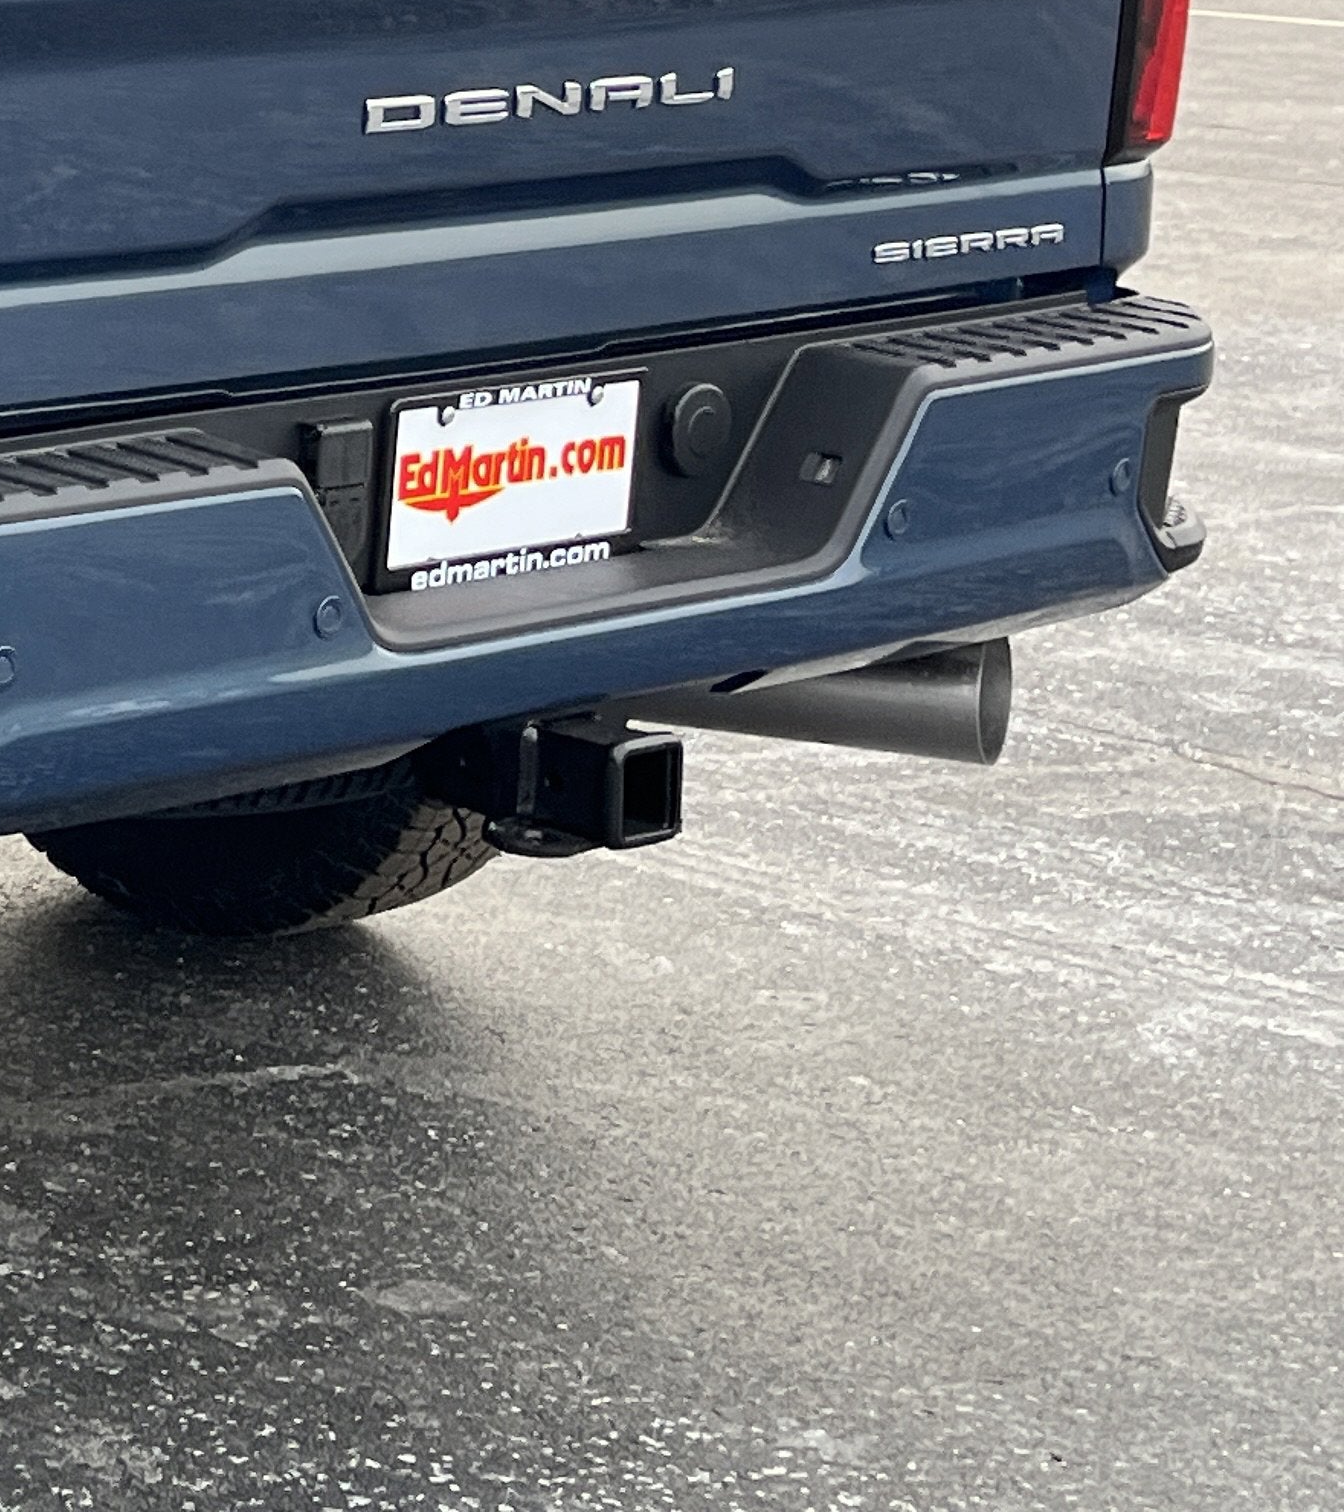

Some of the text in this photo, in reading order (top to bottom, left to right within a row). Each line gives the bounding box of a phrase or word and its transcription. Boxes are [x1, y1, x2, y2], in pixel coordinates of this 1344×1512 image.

[363, 67, 734, 135] DENALI
[873, 222, 1064, 264] SIERRA
[459, 377, 592, 409] ED MARTIN
[398, 436, 626, 501] EdMartin.com
[411, 541, 610, 591] edmartin.com
